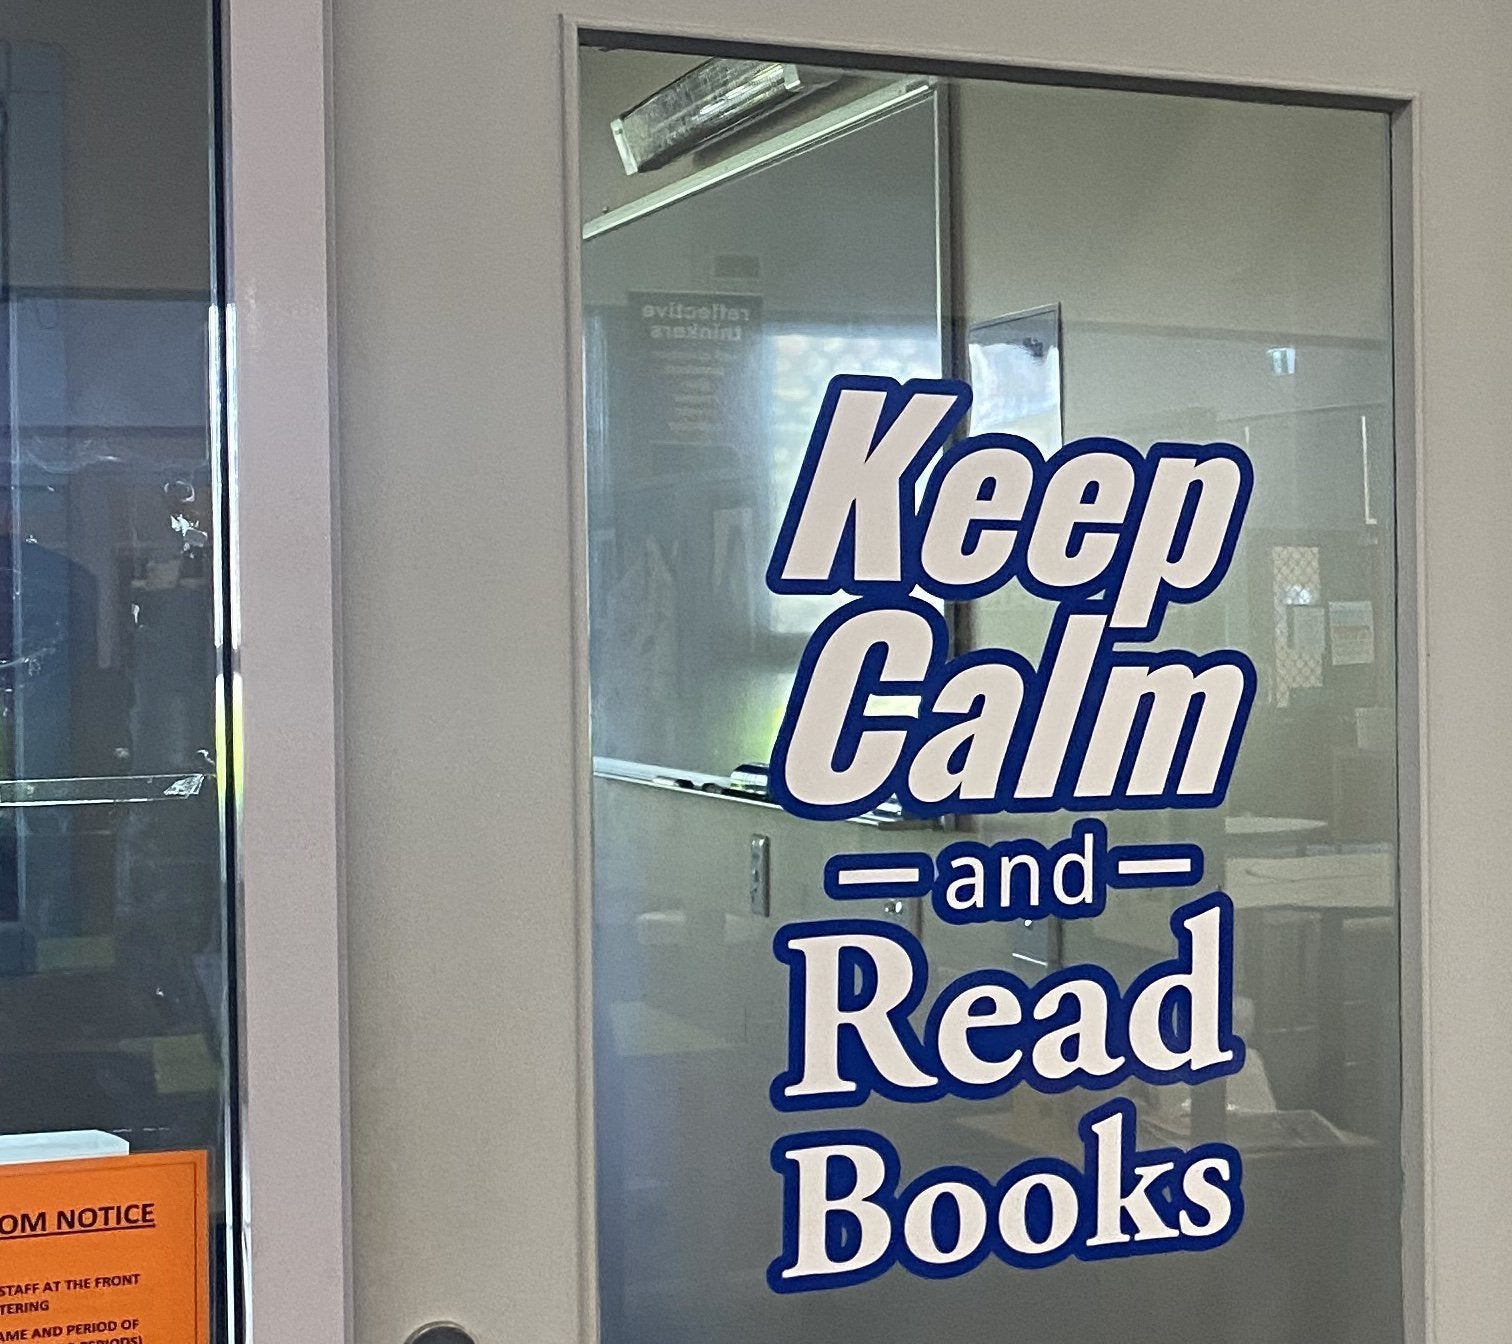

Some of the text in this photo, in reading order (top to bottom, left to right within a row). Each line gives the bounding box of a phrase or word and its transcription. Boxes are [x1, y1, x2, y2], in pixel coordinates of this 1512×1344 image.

[773, 383, 1246, 635] Keep
[776, 601, 1251, 813] Calm
[941, 827, 1101, 916] and
[777, 899, 1239, 1104] Read
[0, 1203, 155, 1236] OM NOTICE
[774, 1105, 1238, 1286] Books
[0, 1273, 140, 1297] STAFF AT THE FRONT
[0, 1300, 49, 1316] TERING
[31, 1326, 63, 1339] AND
[66, 1321, 118, 1336] PERIOD
[121, 1319, 139, 1330] OF
